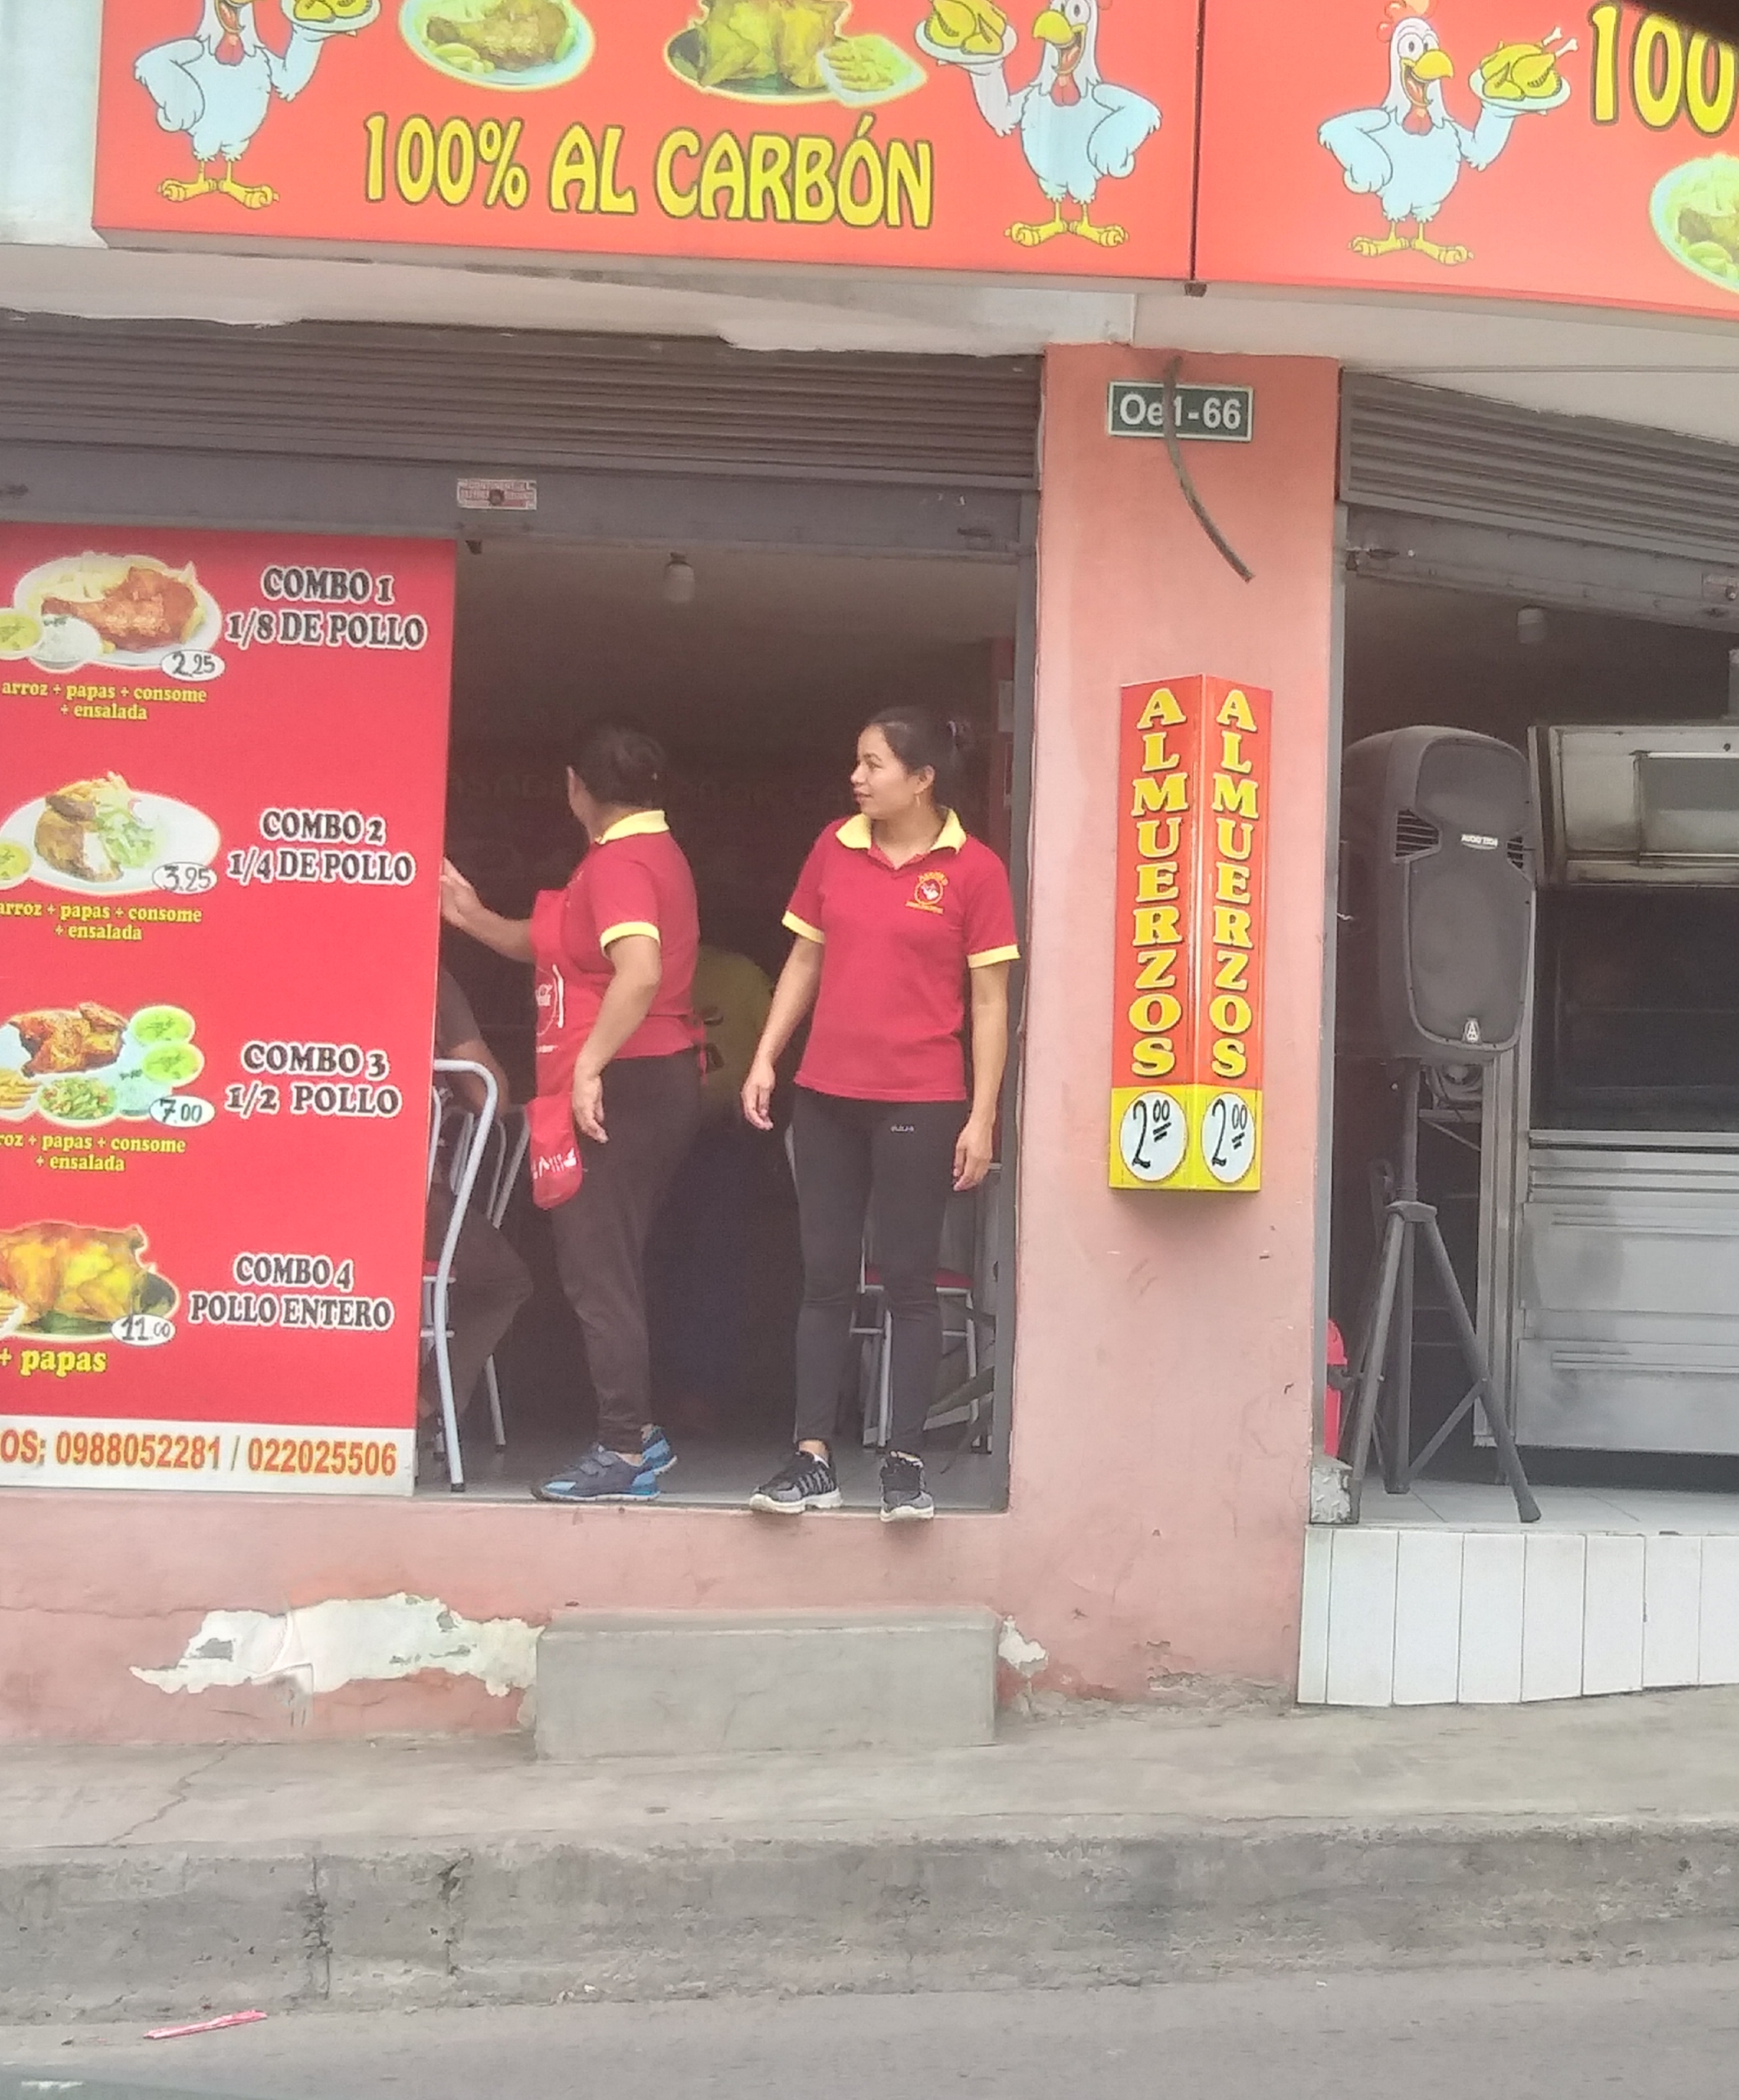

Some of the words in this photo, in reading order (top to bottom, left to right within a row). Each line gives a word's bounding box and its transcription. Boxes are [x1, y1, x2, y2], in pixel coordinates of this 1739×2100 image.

[1589, 3, 1737, 135] 100
[364, 113, 529, 208] 100%
[548, 123, 638, 214] AL
[655, 114, 933, 230] CARBÓN
[1119, 391, 1242, 431] Oe1-66
[262, 565, 372, 604] COMBO
[376, 575, 395, 605] 1
[226, 608, 276, 648] 1/8
[278, 610, 324, 643] DE
[327, 612, 427, 649] POLLO
[2, 680, 48, 698] arroz
[66, 684, 117, 701] papas
[133, 687, 208, 702] consome
[73, 702, 149, 721] ensalada
[261, 808, 363, 843] COMBO
[366, 818, 385, 844] 2
[227, 847, 273, 885] 1/4
[277, 849, 318, 881] DE
[321, 851, 415, 885] POLLO
[1128, 687, 1189, 1077] ALMUERZOS
[1209, 689, 1261, 1078] ALMUERZOS
[60, 904, 111, 921] papas
[127, 907, 203, 923] consome
[67, 923, 143, 941] ensalada
[243, 1041, 362, 1077] COMBO
[366, 1051, 388, 1079] 3
[159, 1098, 204, 1125] 7.00
[226, 1082, 279, 1118] 1/2
[291, 1083, 401, 1117] POLLO
[42, 1134, 94, 1151] papas
[110, 1137, 187, 1154] consome
[48, 1154, 126, 1172] ensalada
[234, 1255, 332, 1287] COMBO
[334, 1260, 355, 1292] 4
[188, 1292, 280, 1325] POLLO
[281, 1297, 395, 1330] ENTERO
[20, 1349, 108, 1379] papas
[1, 1428, 47, 1465] OS:
[55, 1430, 222, 1471] 0988052281
[248, 1438, 399, 1476] 022025506
